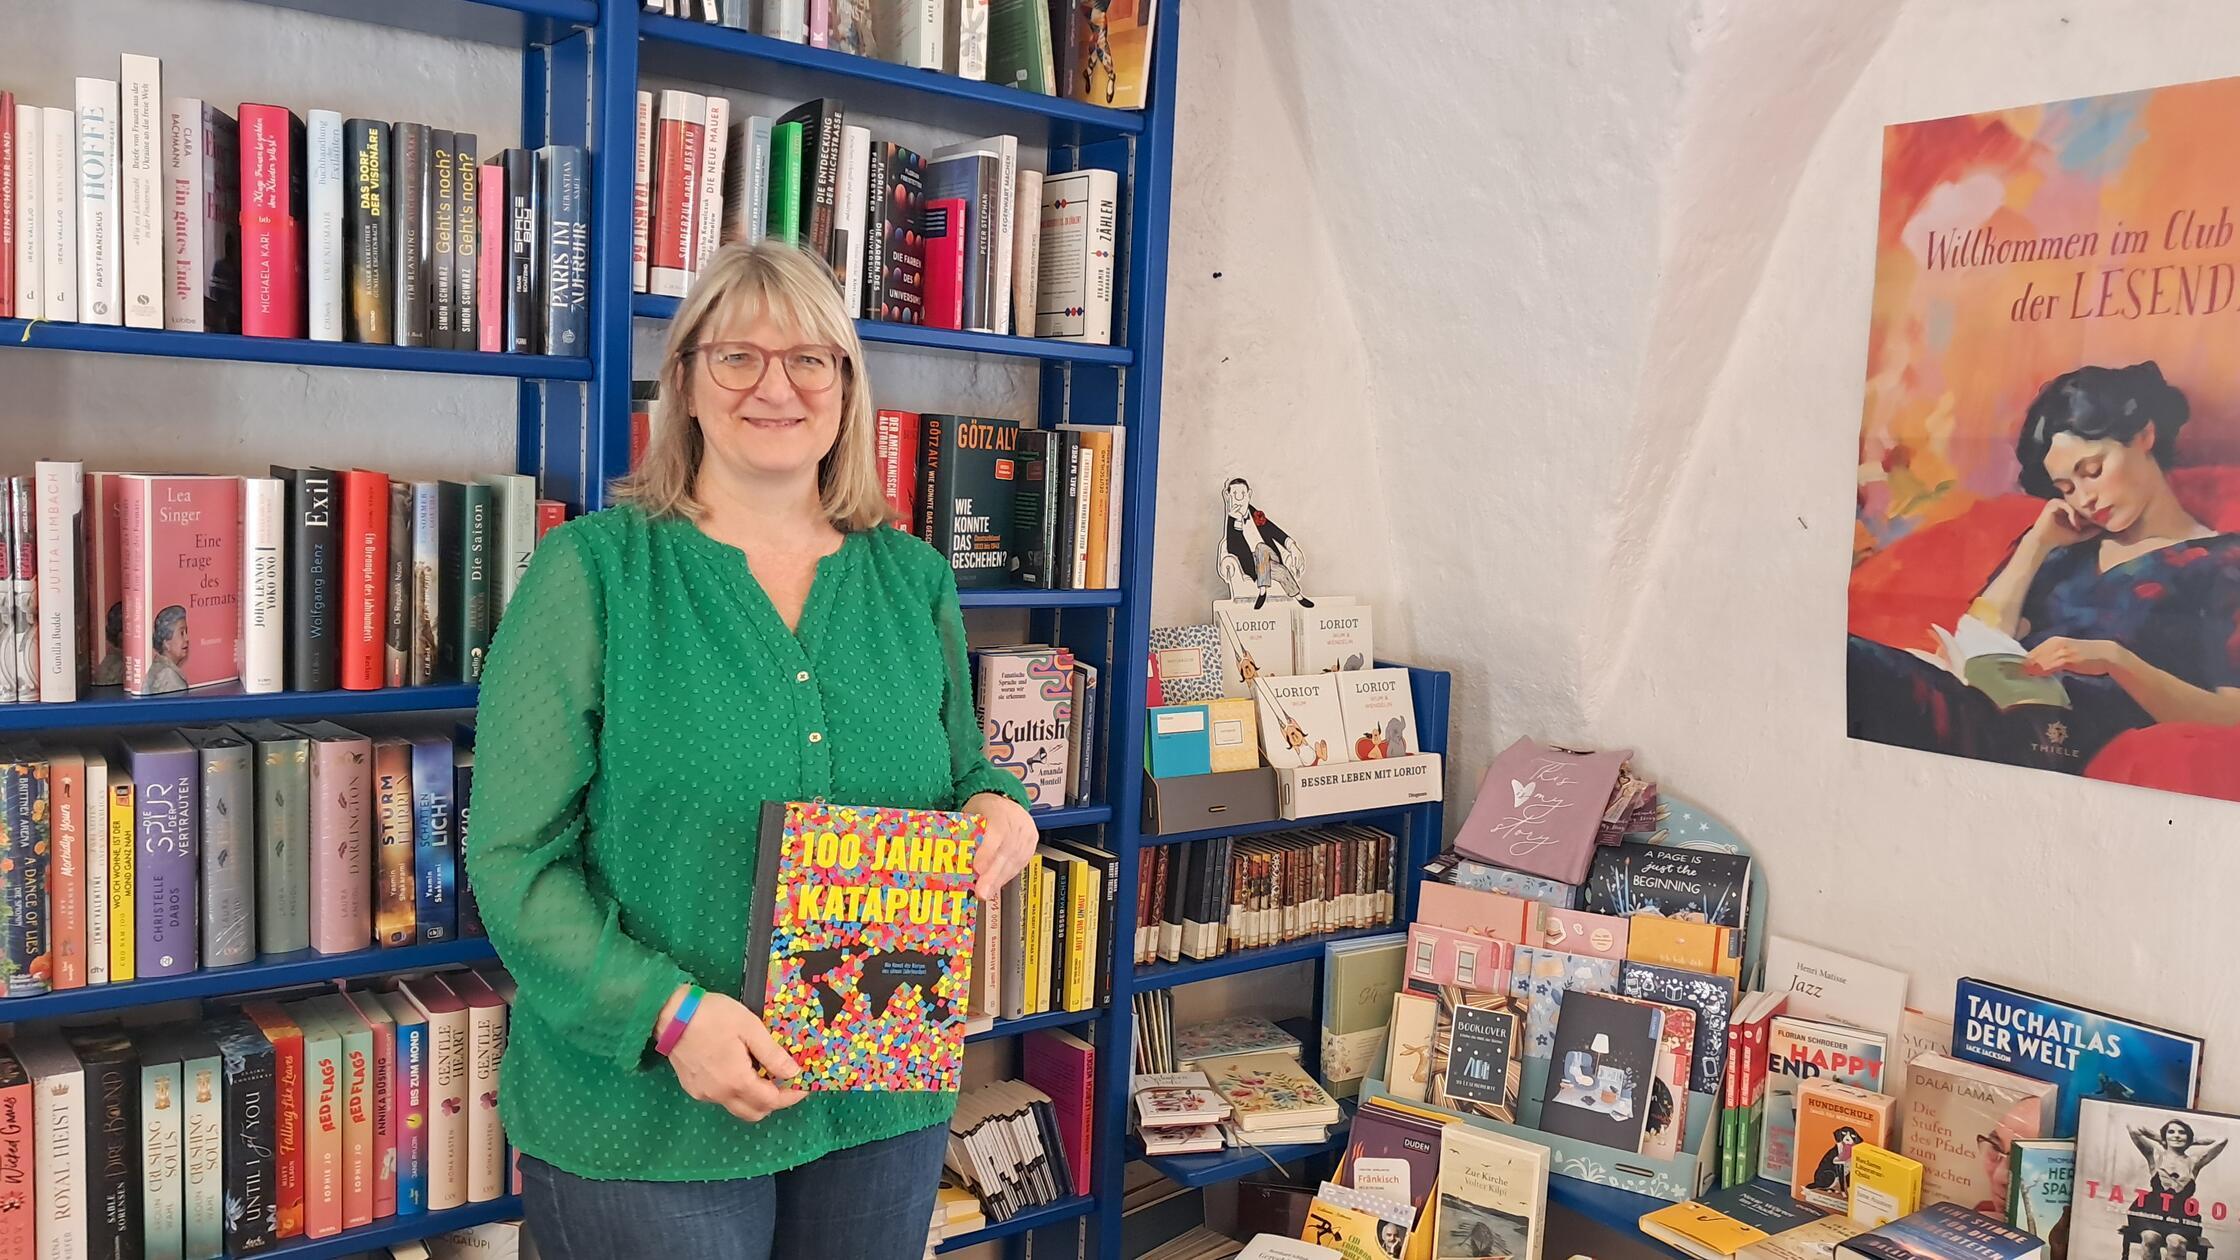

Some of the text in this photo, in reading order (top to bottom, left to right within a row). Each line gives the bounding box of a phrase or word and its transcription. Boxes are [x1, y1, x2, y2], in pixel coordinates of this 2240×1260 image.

[184, 127, 192, 156] CLARA
[706, 107, 719, 194] DIE NEUE MAUER
[819, 117, 832, 184] ENTDECKUNG
[828, 111, 842, 183] MILCHSTRASSE
[361, 150, 370, 209] DAS DORF
[367, 128, 380, 216] DER VISIONÄRE
[877, 162, 885, 202] FLORIAN
[81, 106, 105, 288] PAPST FRANZISKUS HOFFE
[171, 113, 192, 300] BACHMANN Ein gutes Ende
[816, 187, 826, 203] DIE
[825, 186, 834, 205] DER
[514, 196, 524, 253] SPACE
[551, 161, 571, 309] PARIS IM SEBASTIAN
[1096, 199, 1113, 242] ZÄHLEN
[435, 149, 450, 331] SIMON SCHWARZ Geht's noch?
[459, 152, 474, 333] SIMON SCHWARZ Geht's noch?
[874, 239, 882, 274] FARBEN
[1925, 206, 2234, 273] Willkommen im Club
[261, 232, 271, 314] MICHAELA KARL
[571, 222, 587, 313] AUFRUHR
[873, 275, 881, 291] DES
[2010, 264, 2240, 325] der LESEND
[957, 420, 1018, 451] GÖTZ ALY
[886, 416, 899, 498] DER AMERIKANISCHE
[167, 488, 192, 502] Lea
[955, 499, 973, 515] WIE
[159, 507, 201, 525] Singer
[471, 504, 483, 552] Saison
[954, 517, 990, 533] KONNTE
[195, 533, 222, 549] Eine
[305, 478, 329, 639] Wolfgang Benz Exil
[953, 535, 971, 551] DAS
[48, 473, 62, 674] Gunilla Budde JUTTA LIMBACH
[179, 554, 212, 571] Frage
[255, 556, 265, 597] LENNON
[471, 557, 482, 581] Die
[952, 551, 1008, 569] GESCHEHEN?
[200, 573, 220, 588] des
[266, 556, 276, 610] YOKO ONO
[189, 592, 236, 608] Formats
[255, 601, 265, 628] JOHN
[1236, 620, 1276, 632] LORIOT
[1320, 618, 1359, 630] LORIOT
[1275, 686, 1320, 698] LORIOT
[1356, 680, 1396, 694] LORIOT
[1002, 717, 1065, 743] Cultish
[2030, 742, 2081, 758] THIELE
[1301, 765, 1427, 788] BESSER LEBEN MIT LORIOT
[1529, 758, 1578, 785] This
[146, 783, 173, 853] SPUR
[168, 808, 176, 828] DER
[178, 777, 189, 858] VERTRAUTEN
[1523, 791, 1574, 820] my
[58, 803, 74, 877] Morbidly Yours
[350, 776, 360, 875] DARLINGTON
[1490, 816, 1559, 856] story
[421, 792, 433, 898] Yasmin SCHATTEN
[431, 793, 448, 903] Shakarami LICHT
[801, 831, 976, 875] 100 JAHRE
[1644, 849, 1703, 865] A PAGE IS
[124, 830, 132, 897] MOND GANZ NAH
[1641, 861, 1698, 877] just the
[1633, 875, 1701, 895] BEGINNING
[153, 875, 164, 943] CHRISTELLE
[169, 887, 180, 928] DABOS
[797, 885, 968, 926] KATAPULT
[1789, 974, 1823, 999] Jazz
[1796, 962, 1848, 985] Henri Matisse
[1457, 1021, 1507, 1039] BOOKLOVER
[1777, 1029, 1849, 1050] FLORIAN SCHROEDER
[1967, 994, 2122, 1059] TAUCHATLAS
[438, 1025, 450, 1086] GENTLE
[453, 1029, 465, 1078] HEART
[477, 1019, 490, 1080] GENTLE
[1790, 1043, 1883, 1080] HAPPY
[1966, 1019, 2080, 1072] DER WELT
[281, 1055, 295, 1087] Leaves
[410, 1030, 420, 1106] BIS ZUM MOND
[1768, 1053, 1821, 1079] END
[282, 1085, 296, 1110] Like
[375, 1057, 387, 1136] ANNIKA BÜSING
[1915, 1074, 1995, 1105] DALAI LAMA
[246, 1091, 260, 1126] YOU
[349, 1050, 366, 1193] SOPHIE JO RED FLAGS
[1808, 1098, 1874, 1121] HUNDESCHULE
[1913, 1101, 1936, 1118] Die
[280, 1110, 298, 1155] Falling
[318, 1058, 336, 1203] SOPHIE JO RED FLAGS
[1912, 1116, 1953, 1138] Stufen
[247, 1158, 261, 1166] I
[1403, 1138, 1430, 1152] DUDEN
[1909, 1147, 1937, 1162] zum
[1910, 1131, 1977, 1161] des Pfades
[51, 1104, 71, 1222] ROYAL HEIST
[1358, 1174, 1400, 1185] Fränkisch
[1465, 1167, 1509, 1187] Zur Kirche
[107, 1192, 116, 1224] SABLE
[247, 1172, 261, 1222] UNTIL
[2086, 1180, 2240, 1222] TATTOO
